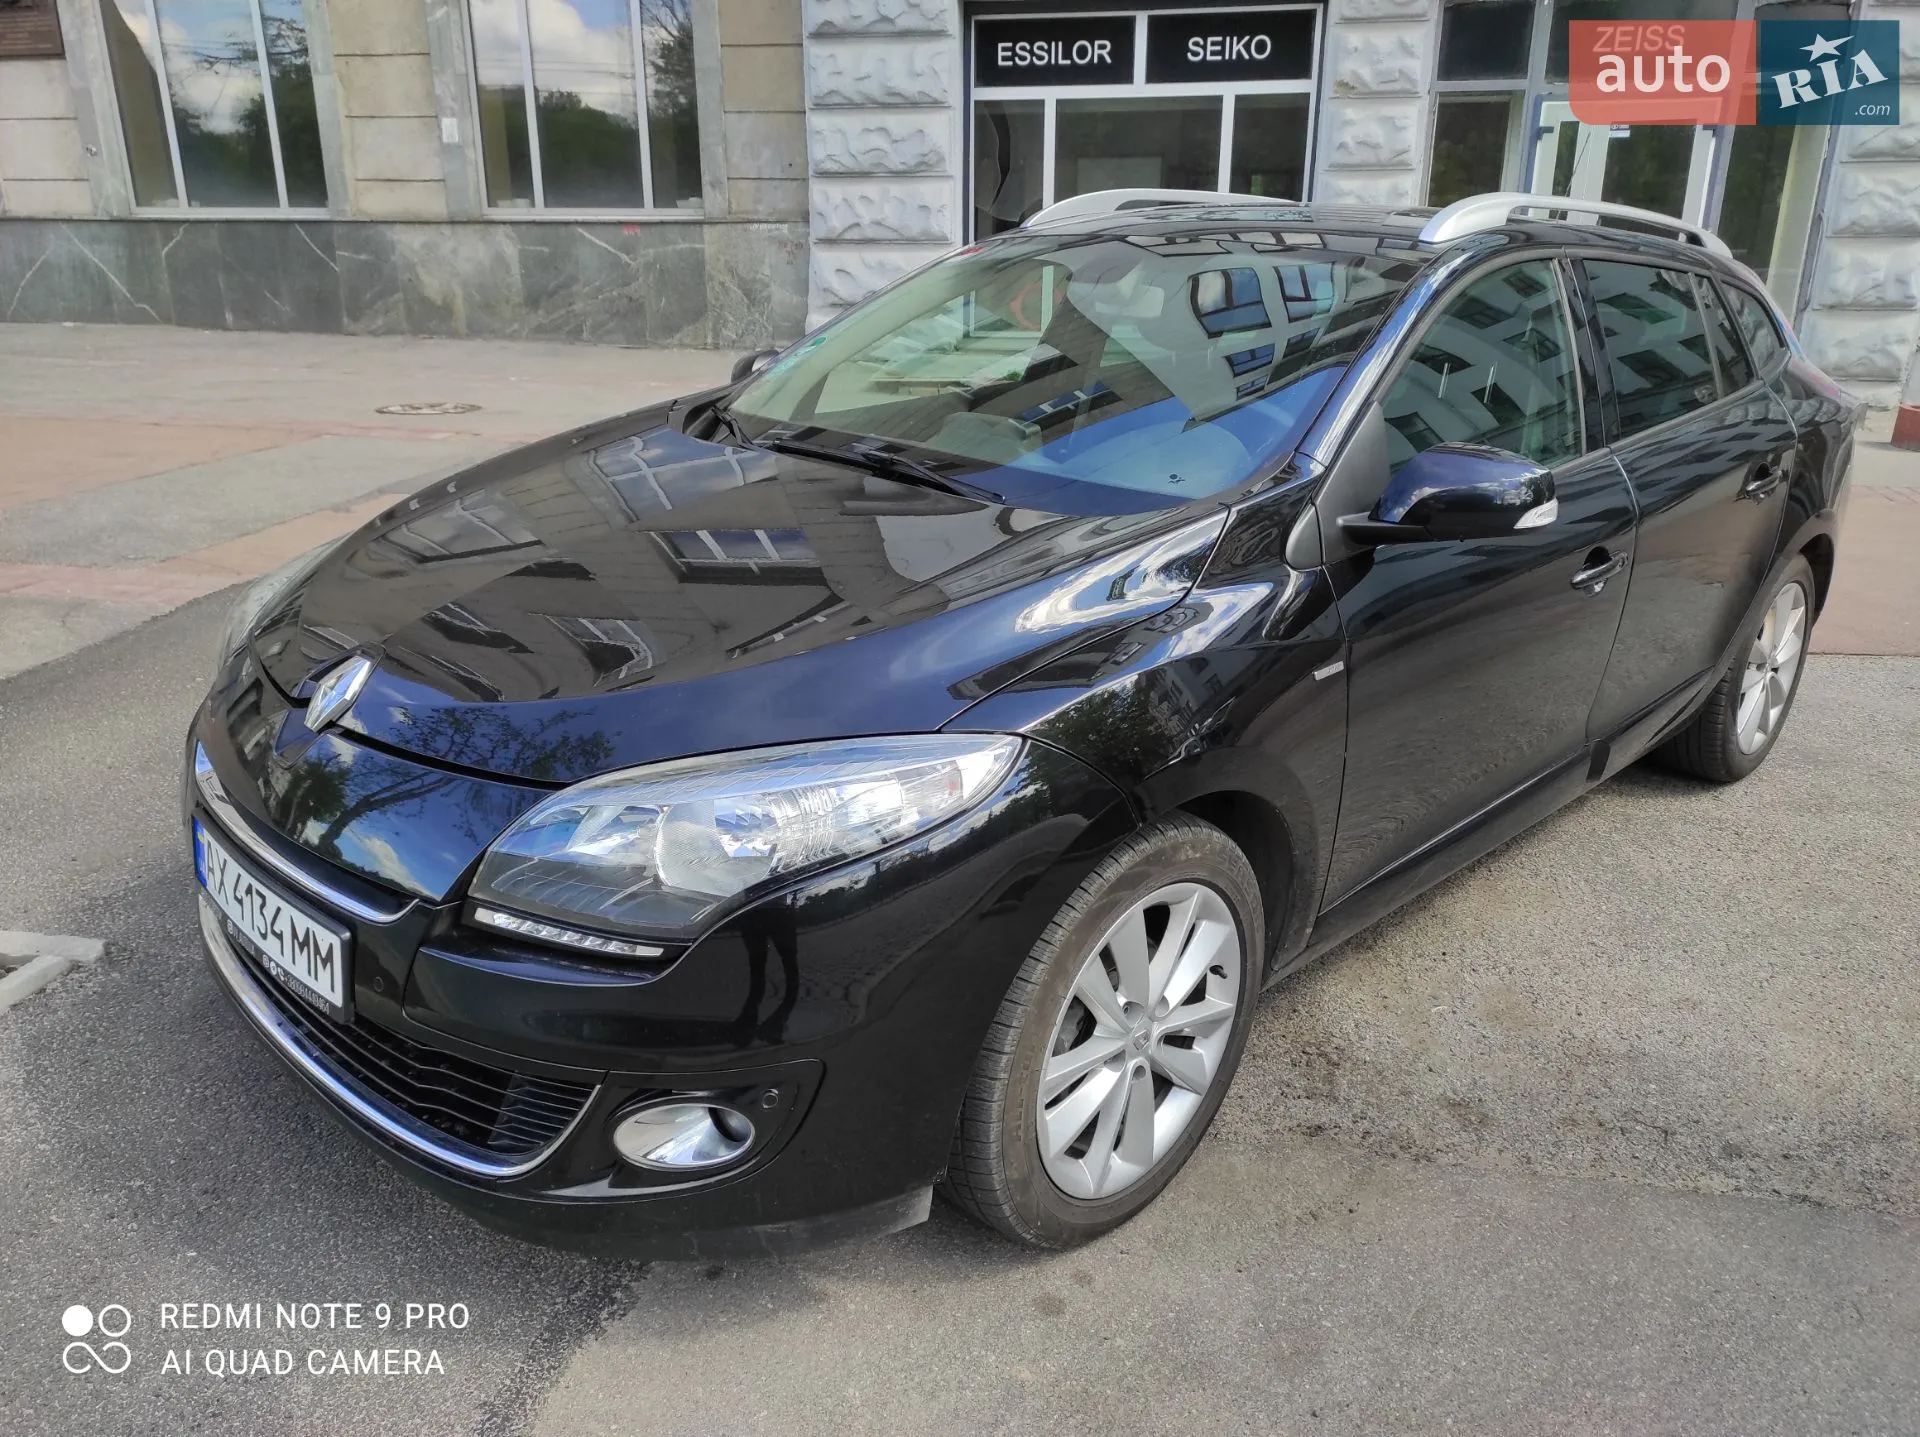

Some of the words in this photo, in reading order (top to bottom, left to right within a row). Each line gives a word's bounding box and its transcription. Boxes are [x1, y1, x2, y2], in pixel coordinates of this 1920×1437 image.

[997, 39, 1113, 67] ESSILOR
[1186, 33, 1273, 63] SEIKO
[1592, 24, 1686, 53] ZEISS
[206, 839, 229, 905] AX
[233, 872, 285, 957] 4134
[289, 914, 336, 994] MM
